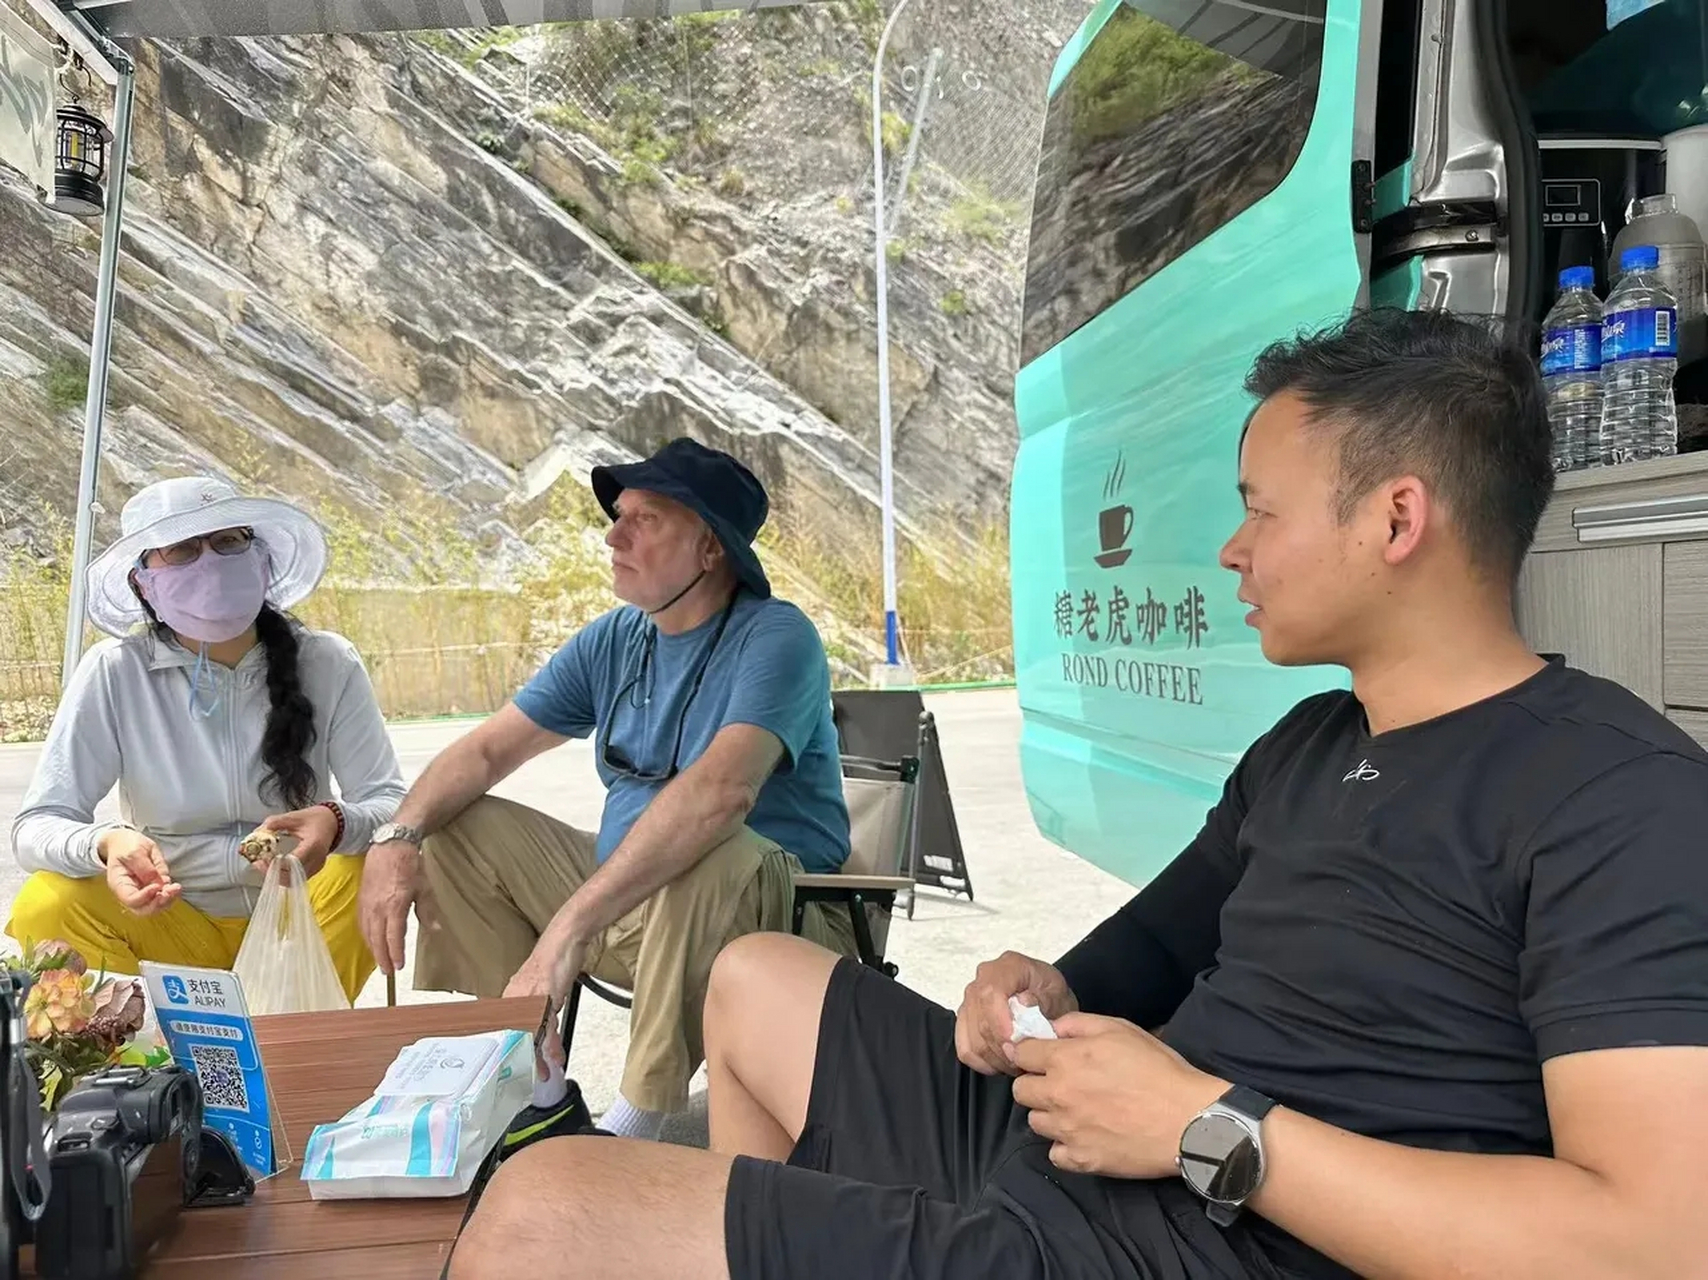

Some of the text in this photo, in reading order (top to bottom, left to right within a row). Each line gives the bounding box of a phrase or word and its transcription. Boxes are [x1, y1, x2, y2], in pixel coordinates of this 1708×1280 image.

[1061, 652, 1204, 706] ROND COFFEE
[187, 979, 224, 995] 支付宝
[194, 995, 226, 1008] ALIPAY
